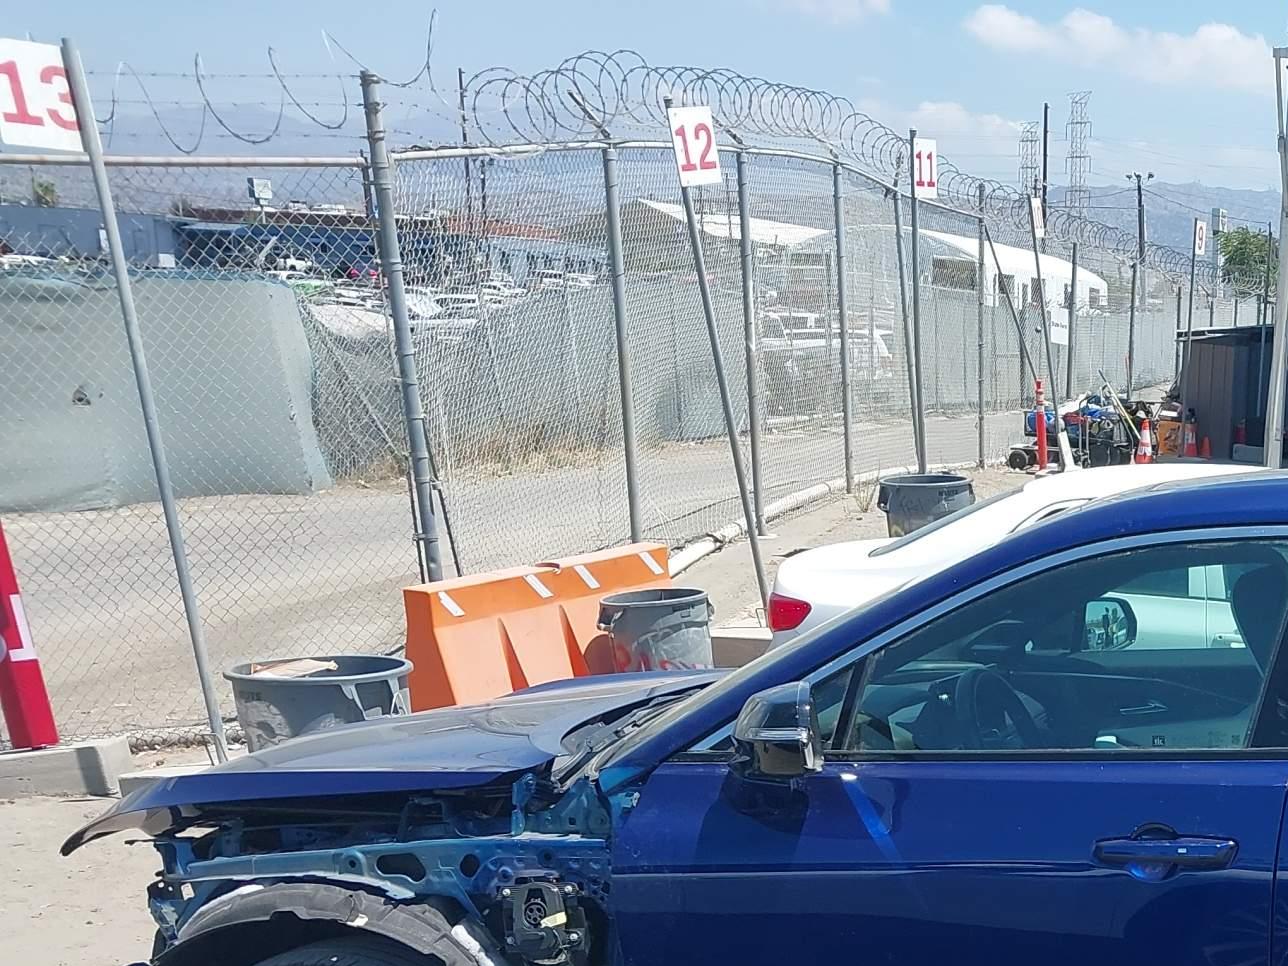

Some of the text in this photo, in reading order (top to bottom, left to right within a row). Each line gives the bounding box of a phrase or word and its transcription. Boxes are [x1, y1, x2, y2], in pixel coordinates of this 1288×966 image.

[0, 60, 81, 131] 13
[674, 123, 717, 172] 12
[915, 150, 936, 187] 11
[1197, 225, 1204, 251] 9
